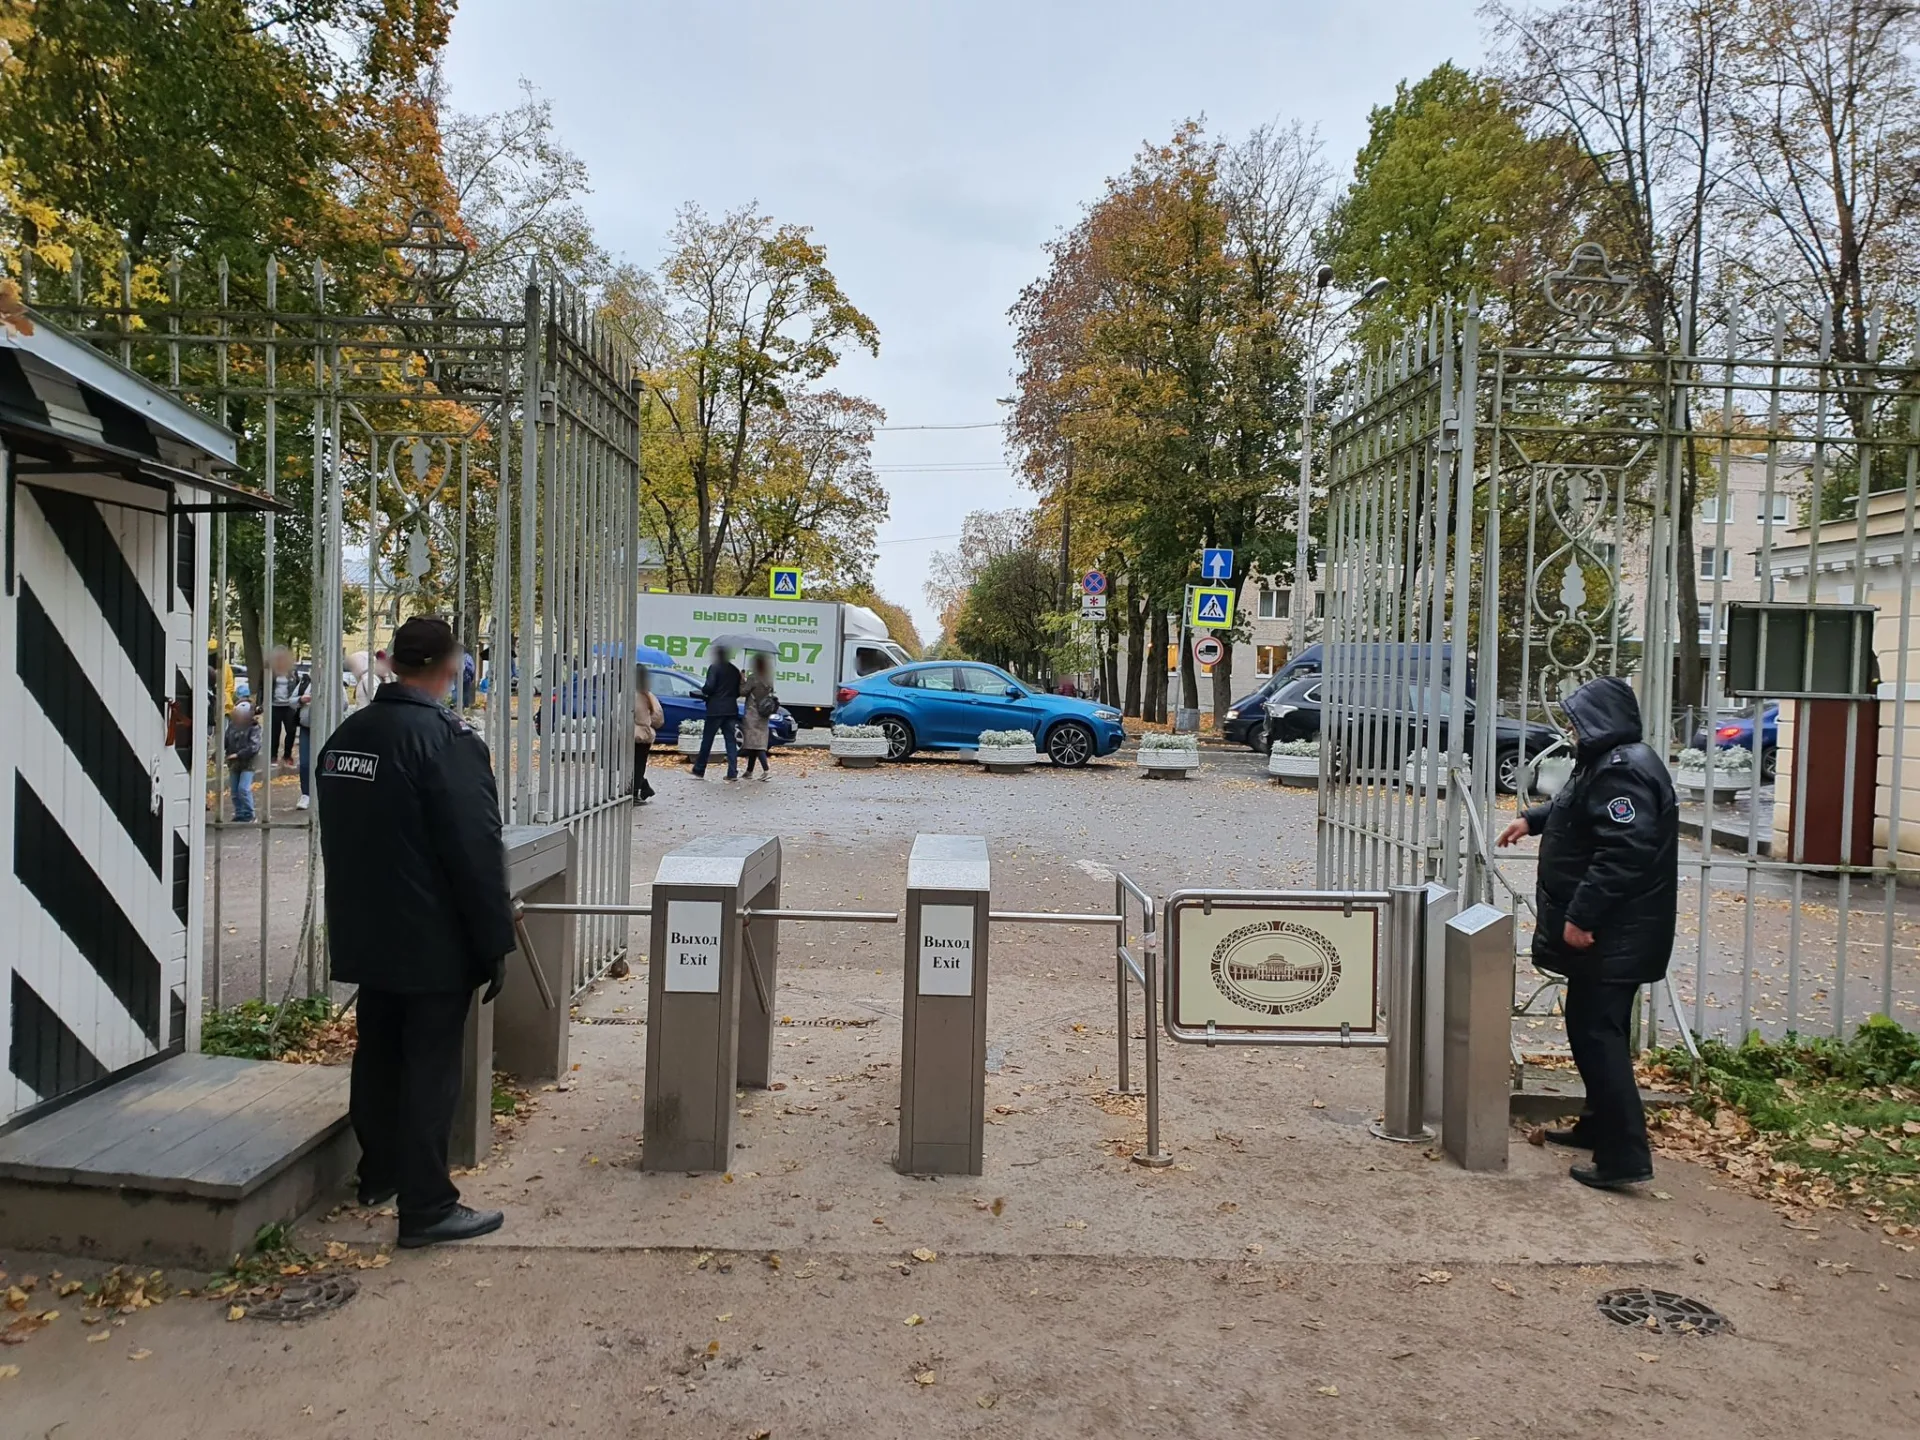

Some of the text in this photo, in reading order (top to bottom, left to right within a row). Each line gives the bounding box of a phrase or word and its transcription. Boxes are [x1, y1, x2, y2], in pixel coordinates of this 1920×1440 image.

[693, 611, 818, 626] ВЫВОЗ МУСОРА
[670, 931, 718, 947] Выход
[923, 935, 970, 950] Выход
[679, 952, 708, 967] Exit
[932, 956, 961, 970] Exit
